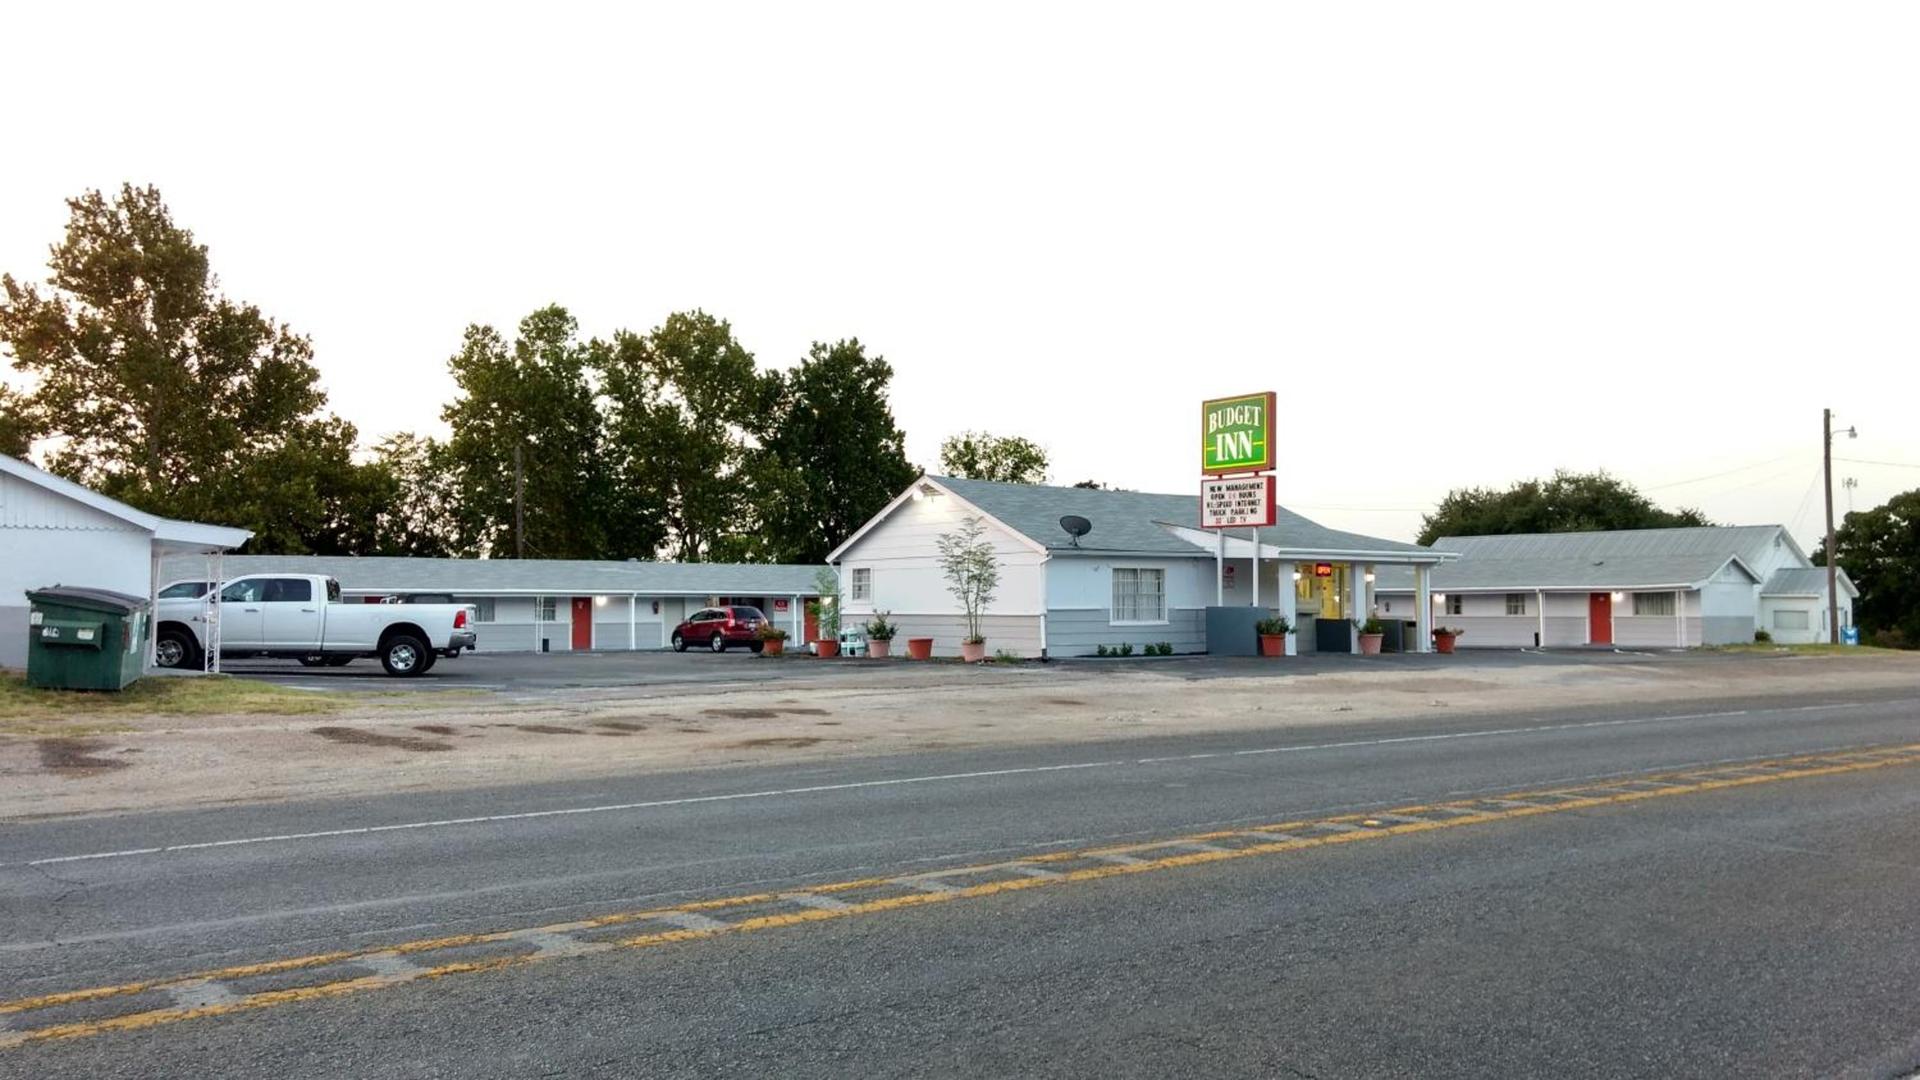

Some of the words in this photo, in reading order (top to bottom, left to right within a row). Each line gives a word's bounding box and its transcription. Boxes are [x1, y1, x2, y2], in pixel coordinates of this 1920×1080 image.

[1209, 405, 1261, 434] BUDGET
[1216, 430, 1253, 461] INN
[1226, 482, 1263, 491] MANAGEMENT
[1235, 499, 1261, 507] INTERNET
[1230, 507, 1257, 516] PARKING
[1317, 566, 1331, 574] OPEN
